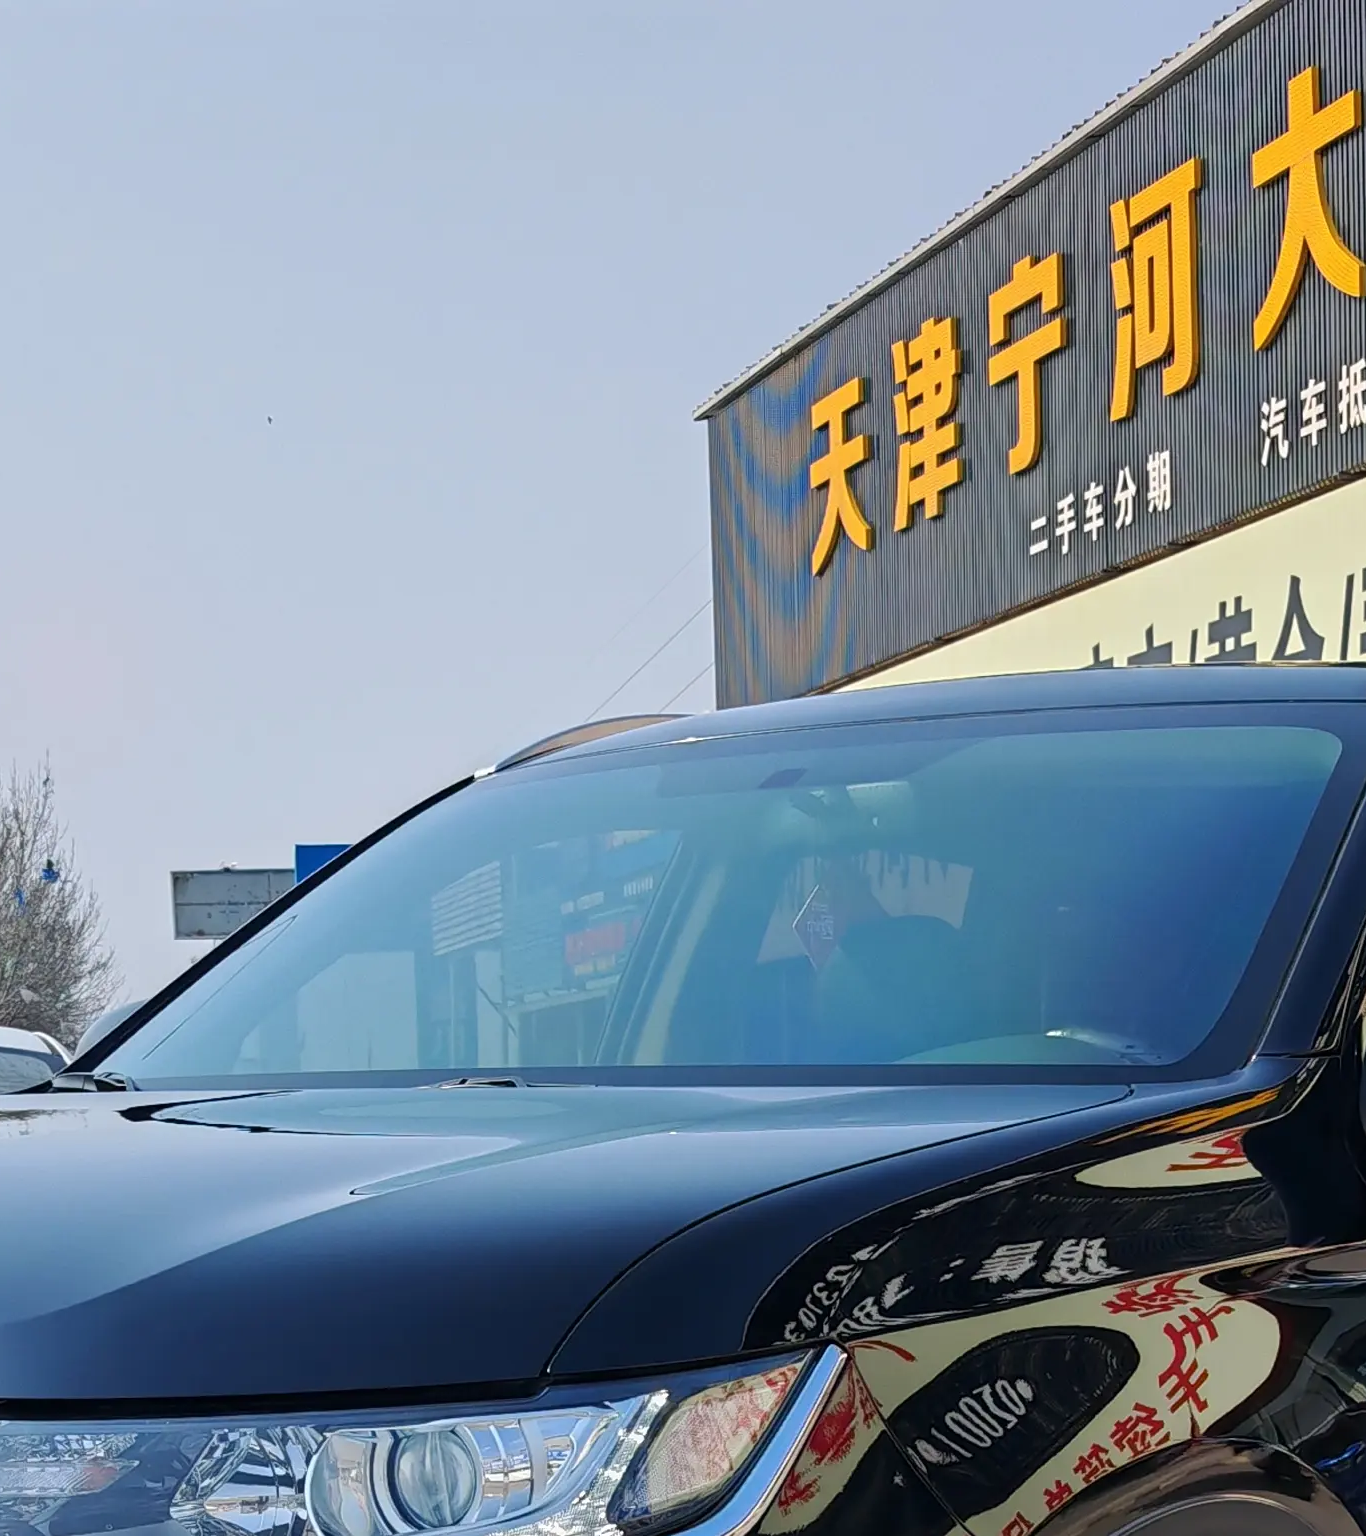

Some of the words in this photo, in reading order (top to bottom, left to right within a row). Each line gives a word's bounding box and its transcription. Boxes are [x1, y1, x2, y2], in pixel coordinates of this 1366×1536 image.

[1029, 449, 1173, 556] 二手车分期
